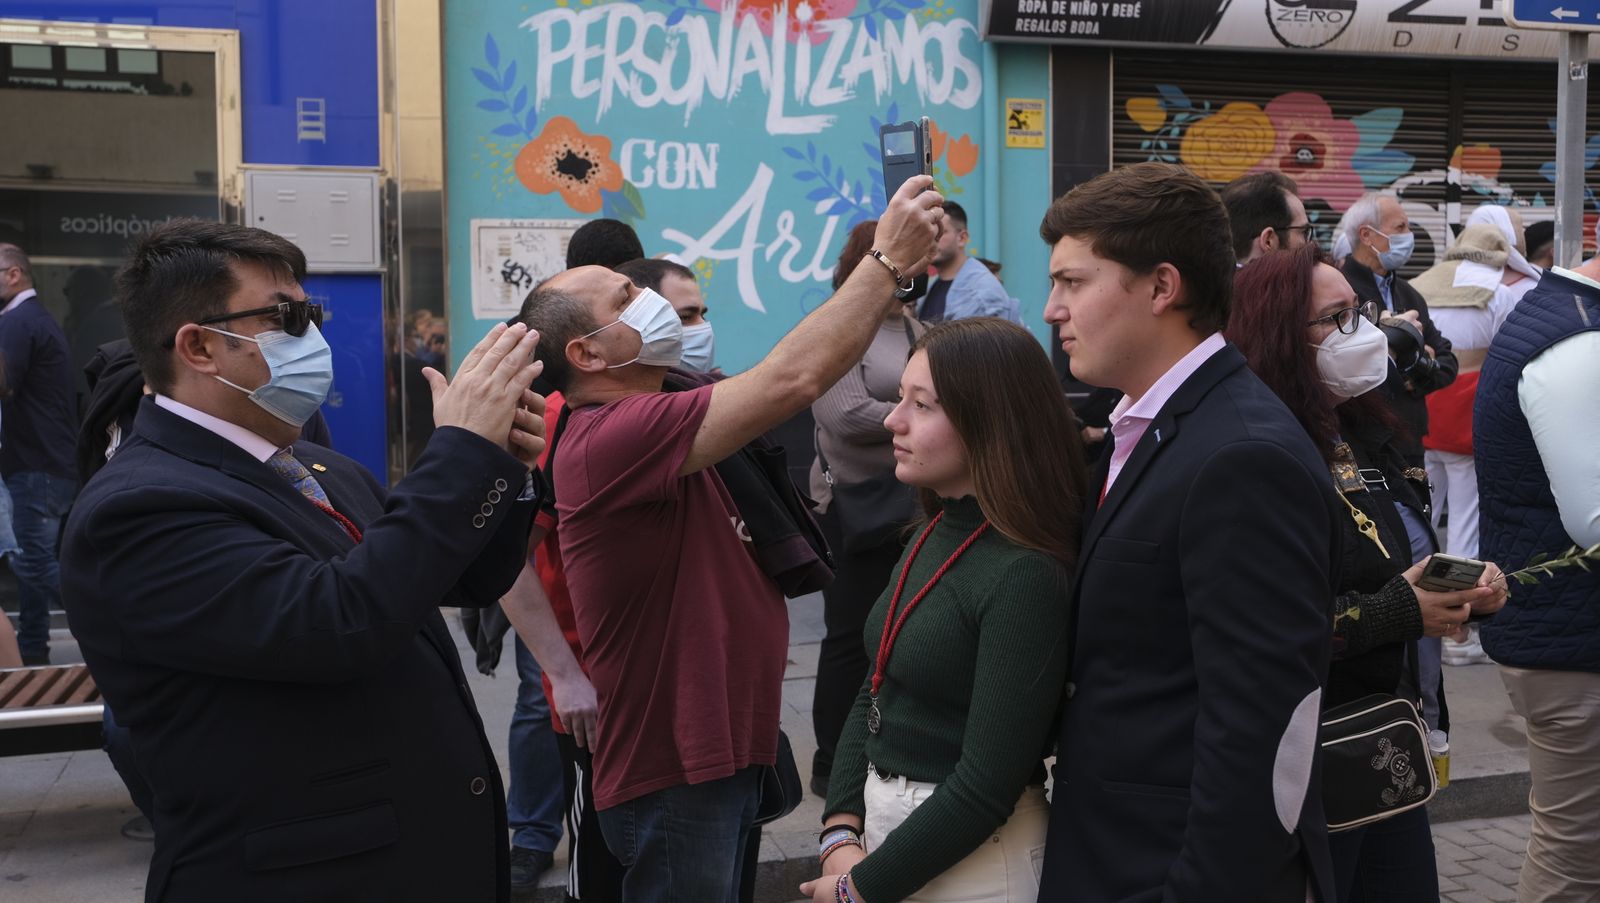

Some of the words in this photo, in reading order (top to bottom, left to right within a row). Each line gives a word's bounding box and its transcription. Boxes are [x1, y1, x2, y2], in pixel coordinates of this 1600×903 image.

[1018, 0, 1048, 14] ROPA
[1051, 1, 1066, 15] DE
[1070, 0, 1098, 17] NIÑO
[1101, 3, 1110, 17] Y
[1112, 1, 1141, 18] BEBÉ
[1276, 8, 1344, 23] ZERO
[1015, 18, 1067, 34] REGALOS
[1070, 20, 1099, 35] BODA
[620, 138, 720, 190] CON
